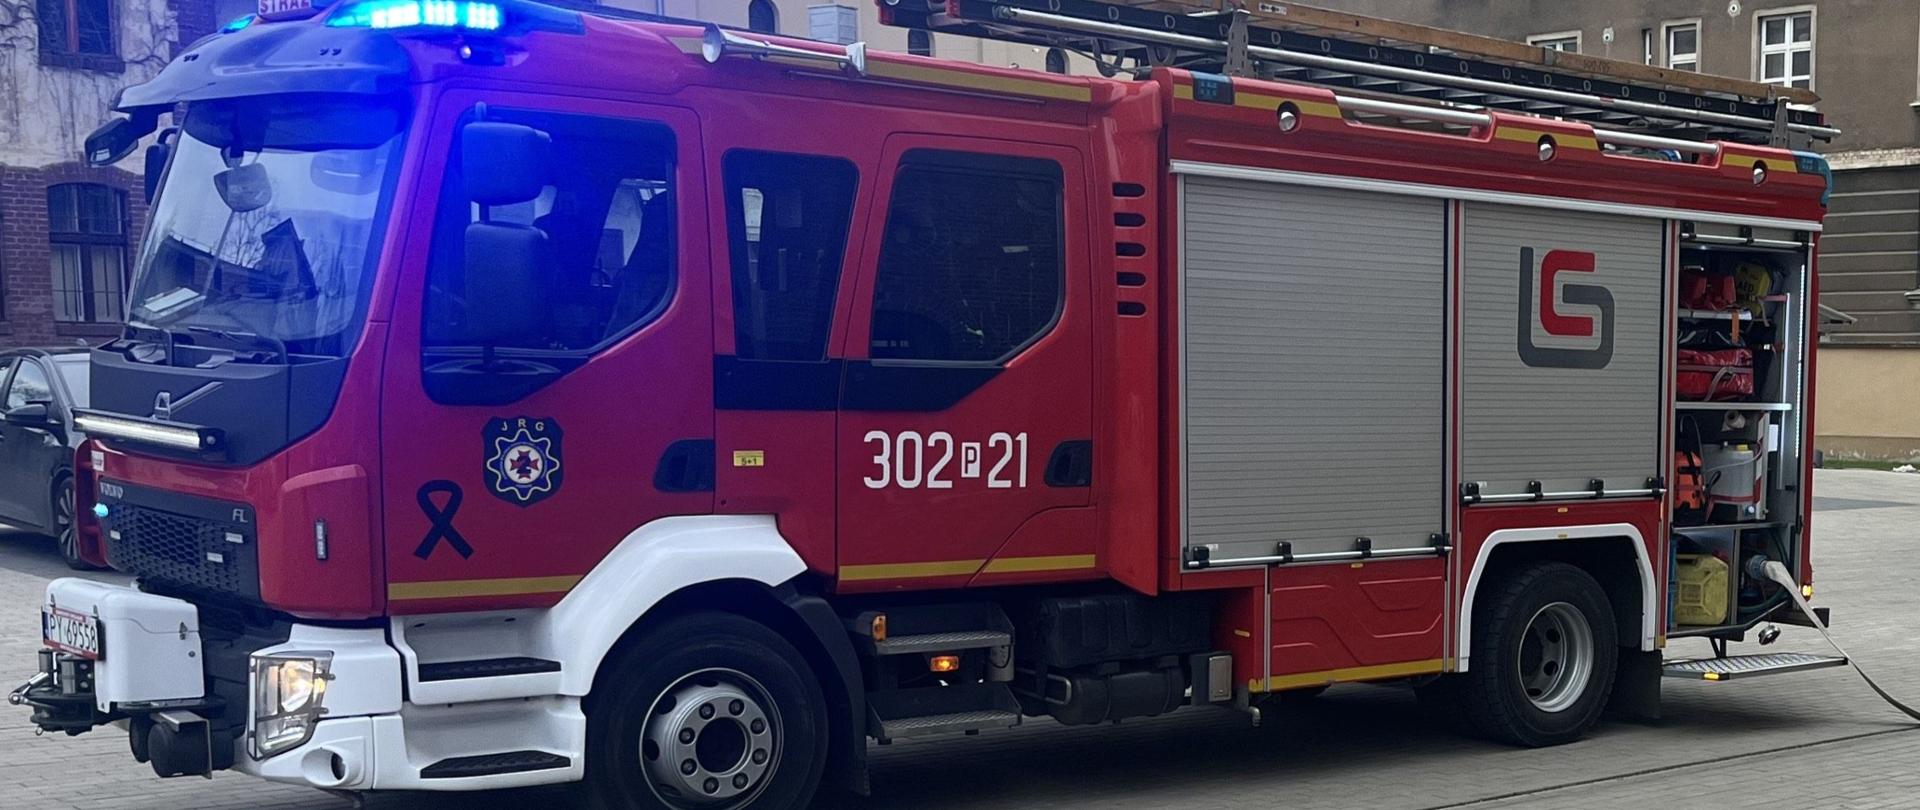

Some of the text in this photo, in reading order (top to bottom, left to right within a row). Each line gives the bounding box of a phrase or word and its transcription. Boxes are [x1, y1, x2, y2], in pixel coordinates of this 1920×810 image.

[863, 430, 1028, 489] 302 P 21
[232, 508, 249, 523] FL
[50, 614, 97, 652] PY 69558
